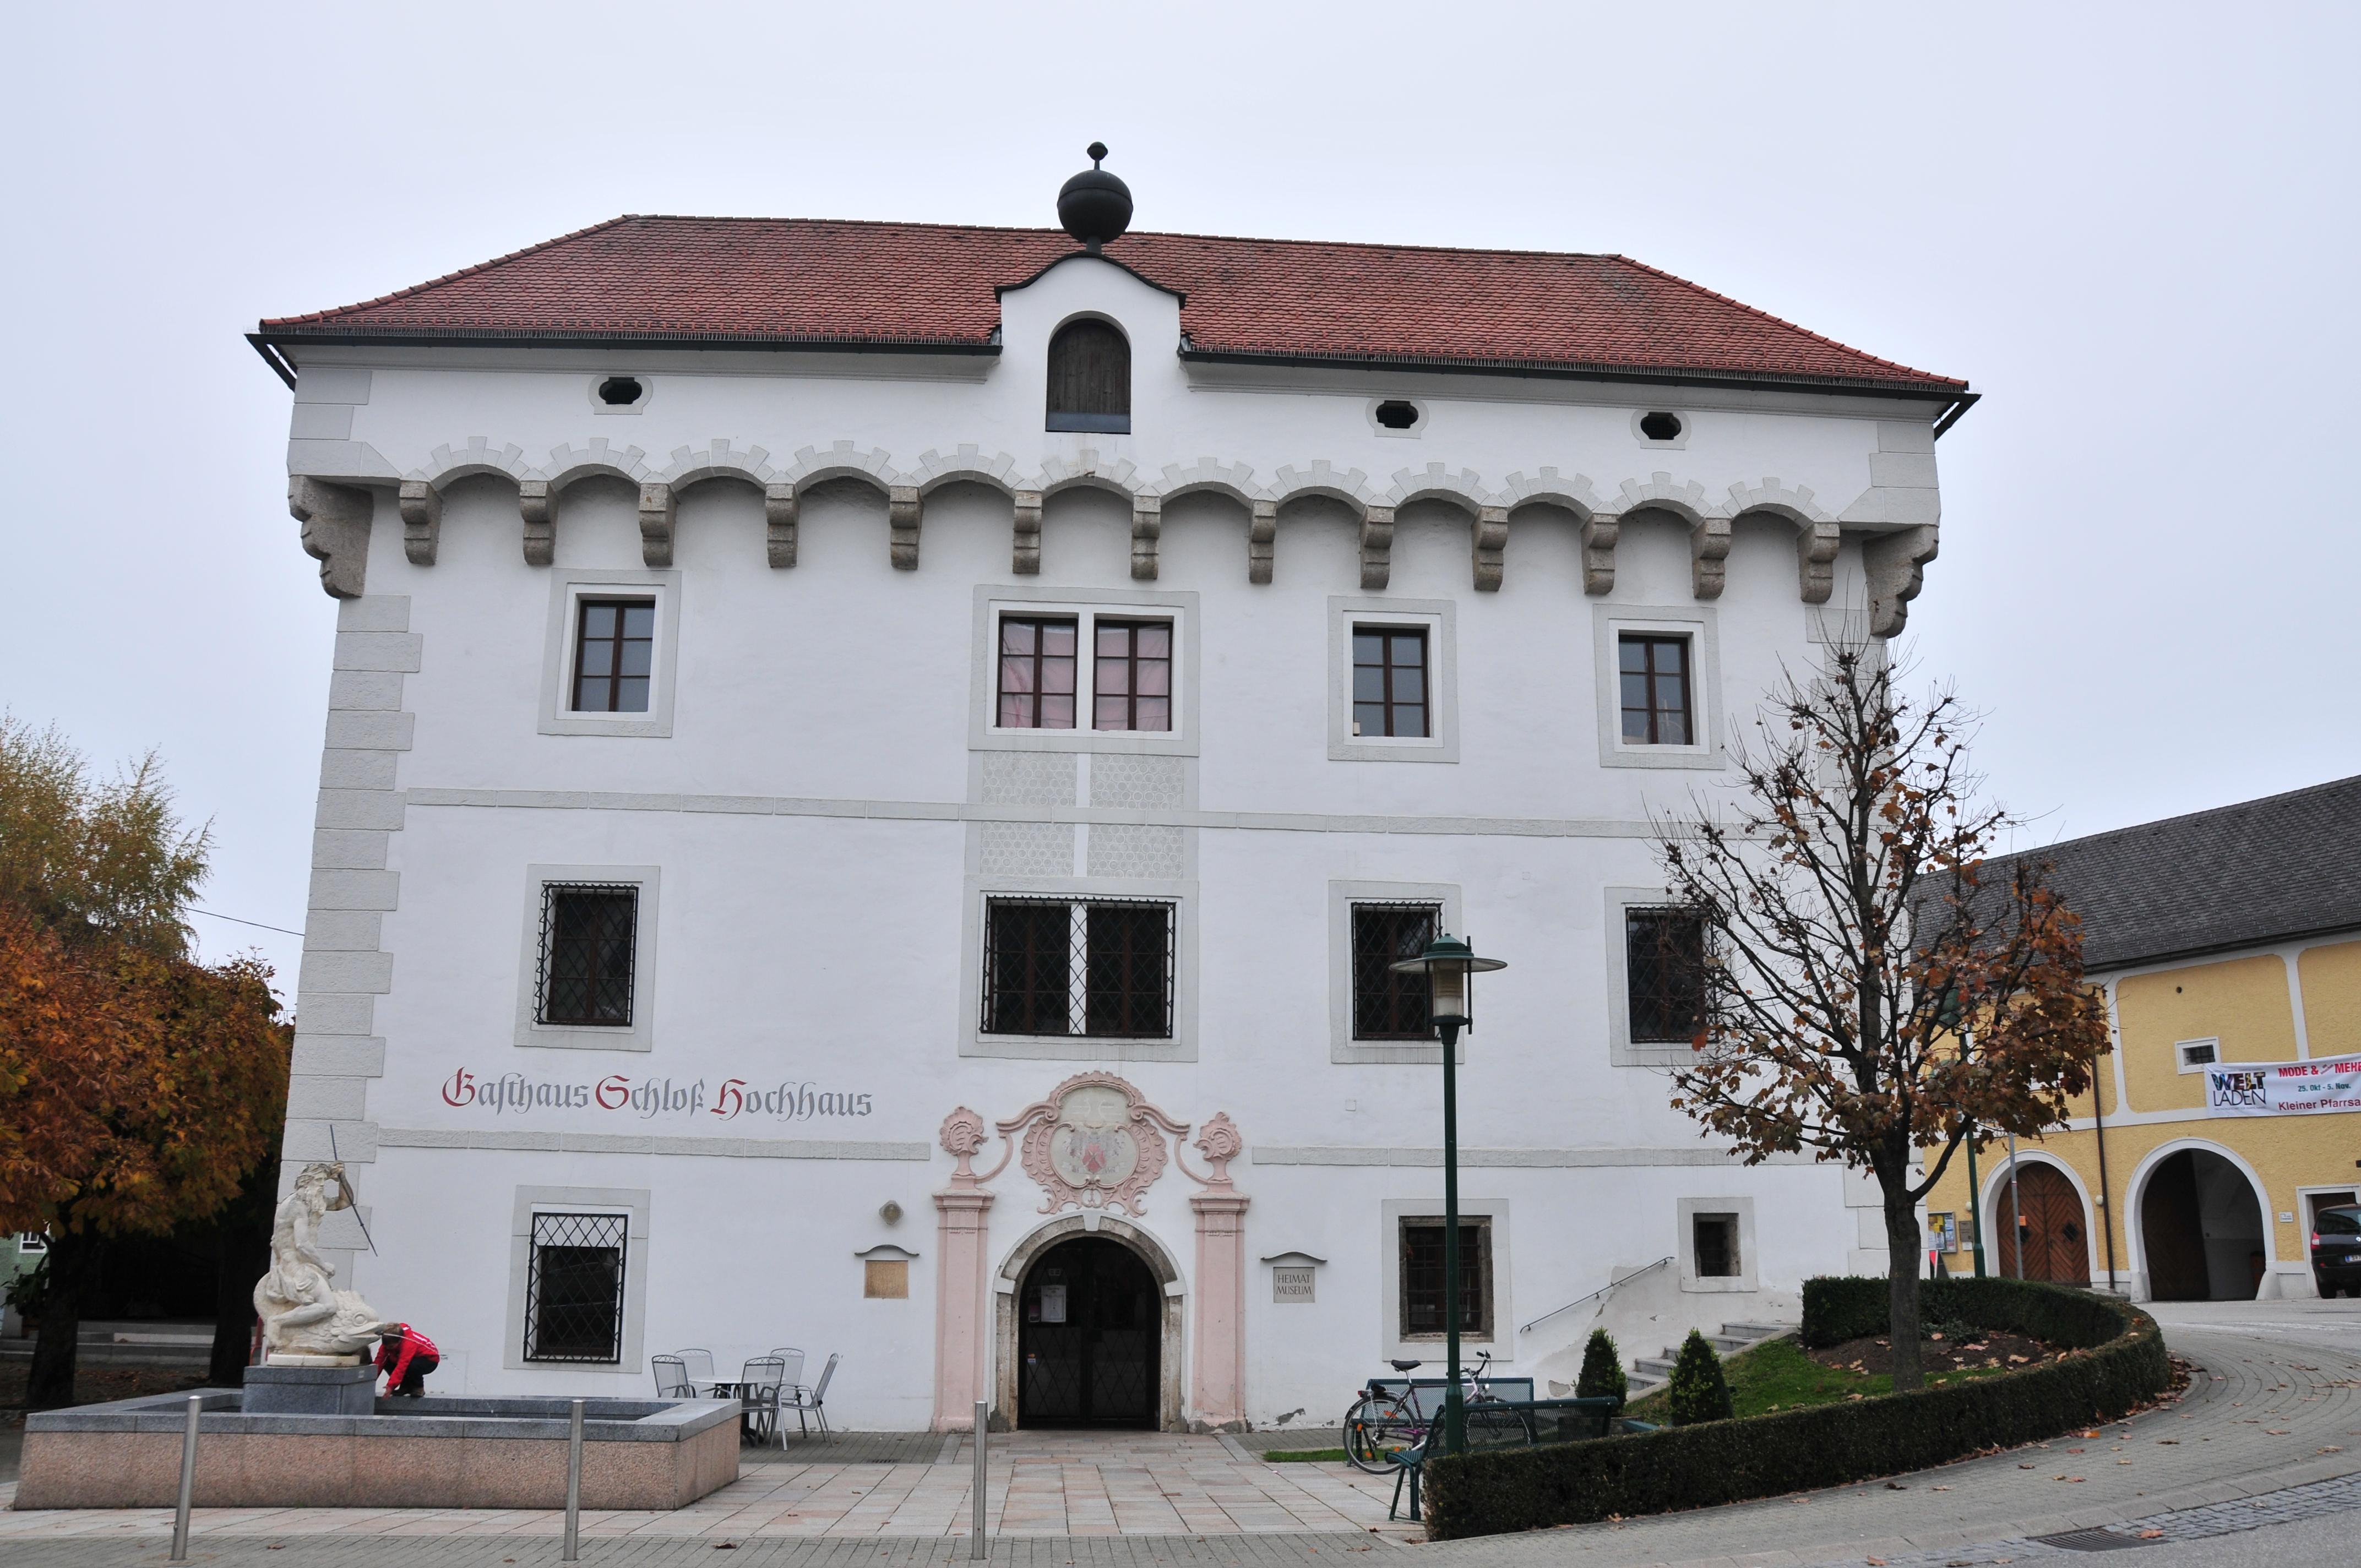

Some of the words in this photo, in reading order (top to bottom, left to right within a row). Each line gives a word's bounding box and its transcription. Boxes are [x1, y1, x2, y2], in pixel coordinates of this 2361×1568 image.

[2278, 1066, 2308, 1077] MODE
[2311, 1065, 2319, 1075] &
[2211, 1071, 2266, 1091] WELT
[595, 1074, 705, 1119] Schloß
[710, 1078, 873, 1121] Hochhaus
[2213, 1088, 2266, 1106] LADEN
[2278, 1101, 2317, 1111] Kleiner
[1277, 1274, 1310, 1283] HEIMAT
[1276, 1286, 1312, 1295] MUSEUM
